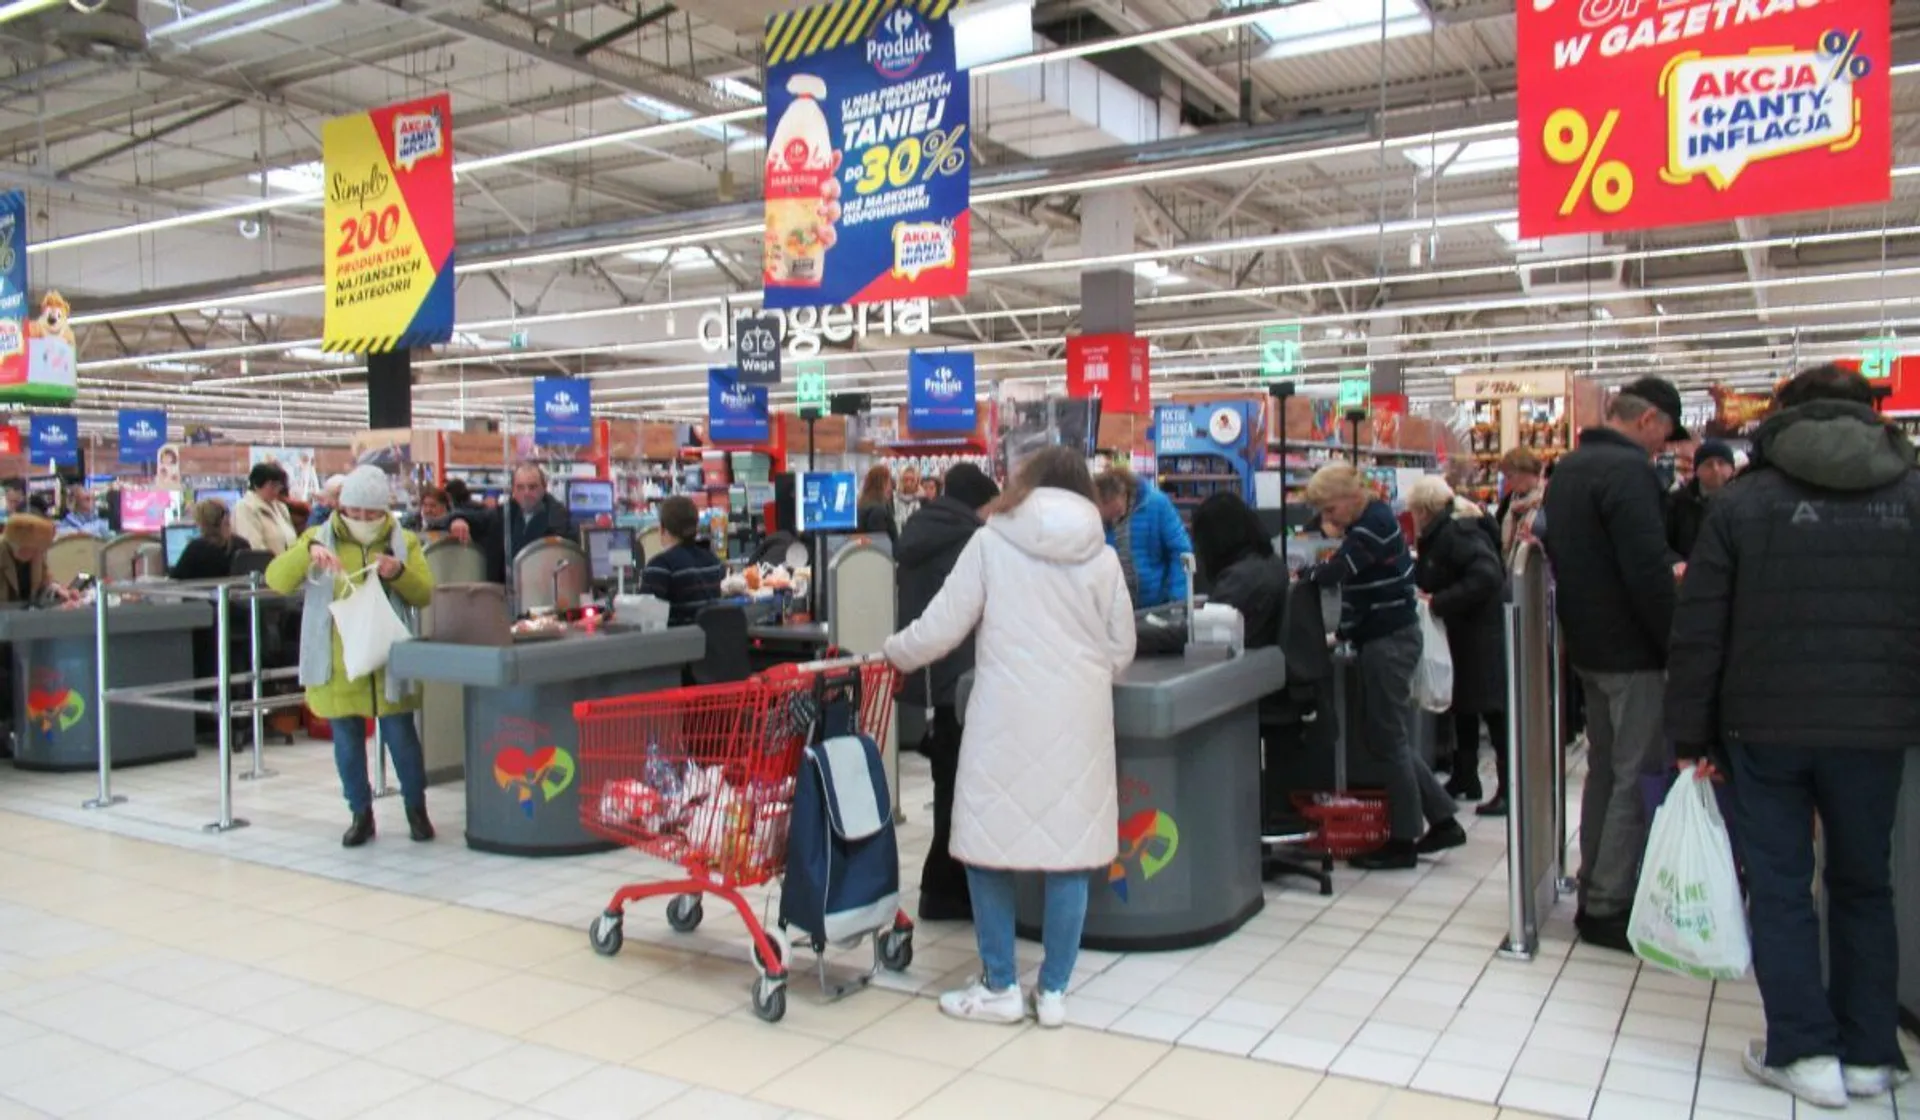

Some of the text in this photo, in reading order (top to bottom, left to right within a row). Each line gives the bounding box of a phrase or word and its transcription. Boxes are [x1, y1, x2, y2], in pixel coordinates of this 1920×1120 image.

[867, 31, 932, 65] Produkt
[1554, 36, 1592, 70] W
[880, 73, 945, 98] PRODUKTY
[1690, 63, 1818, 101] AKCJA
[843, 99, 946, 151] TANIEJ
[1688, 113, 1832, 158] INFLACJA
[845, 124, 966, 194] DO 30%
[865, 184, 926, 207] MARKOWE
[336, 203, 401, 258] 200
[902, 231, 941, 243] AKCJA
[335, 278, 411, 308] W KATEGORII
[742, 359, 775, 372] Waga
